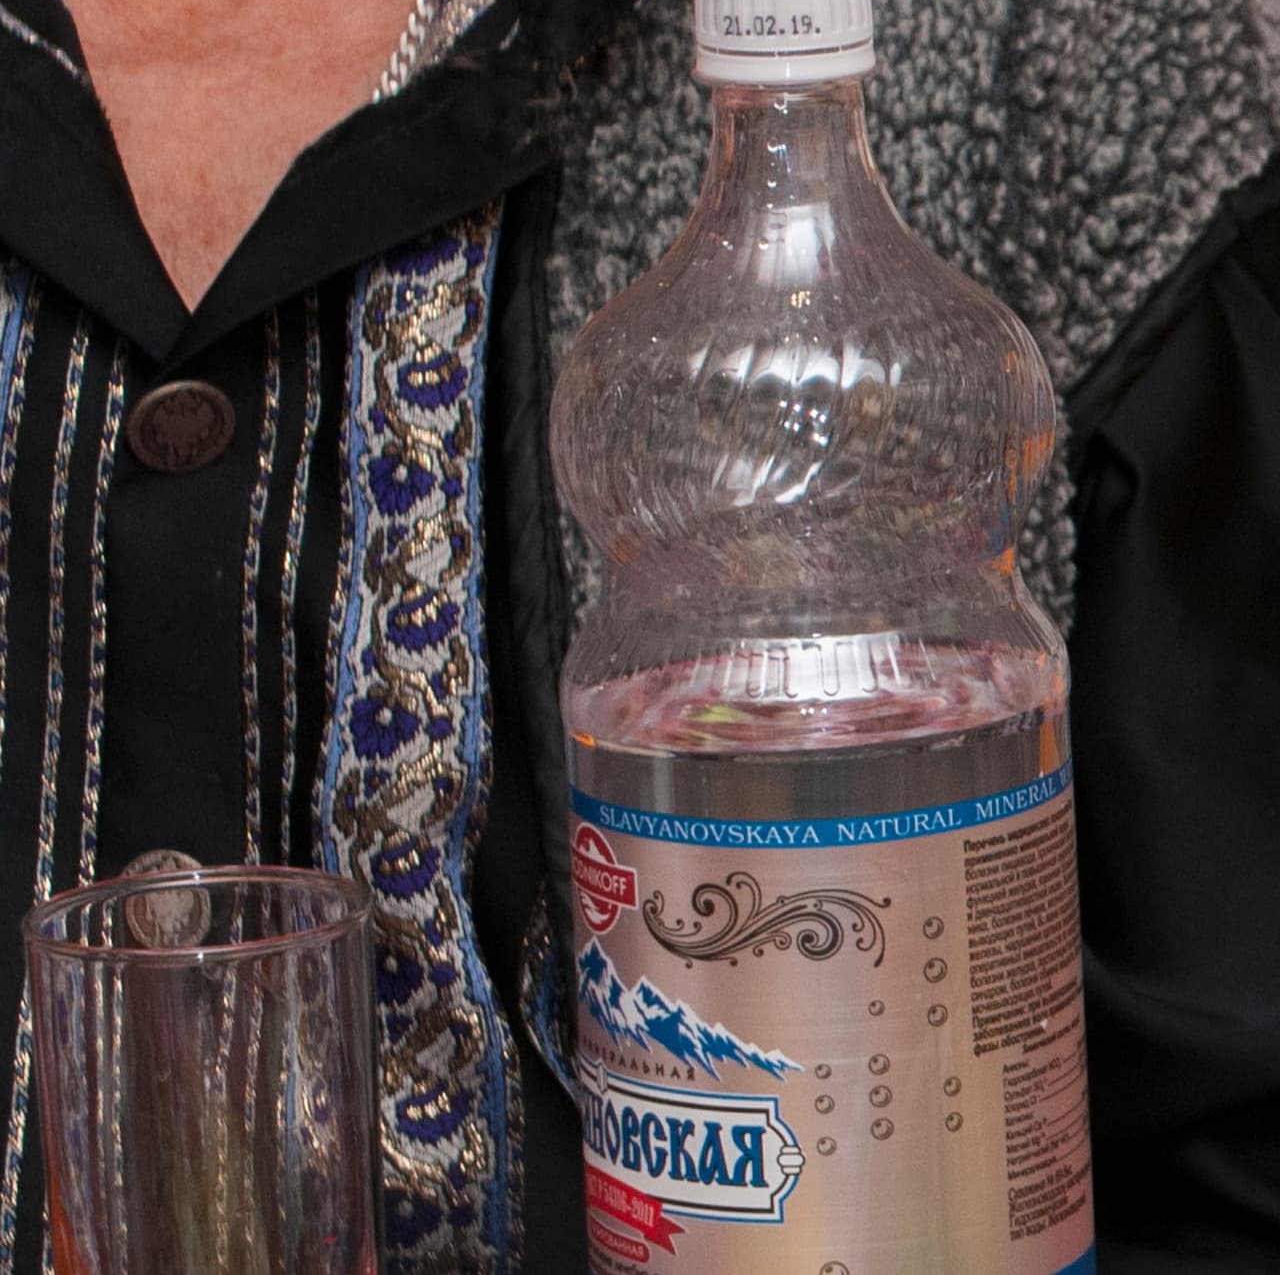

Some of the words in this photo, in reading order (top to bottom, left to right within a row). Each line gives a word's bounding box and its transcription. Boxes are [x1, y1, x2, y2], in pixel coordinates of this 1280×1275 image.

[723, 14, 821, 36] 21.02.19.
[600, 806, 820, 844] SLAVYANOVSKAYA
[838, 809, 962, 842] NATURAL
[975, 777, 1056, 821] MINERAL
